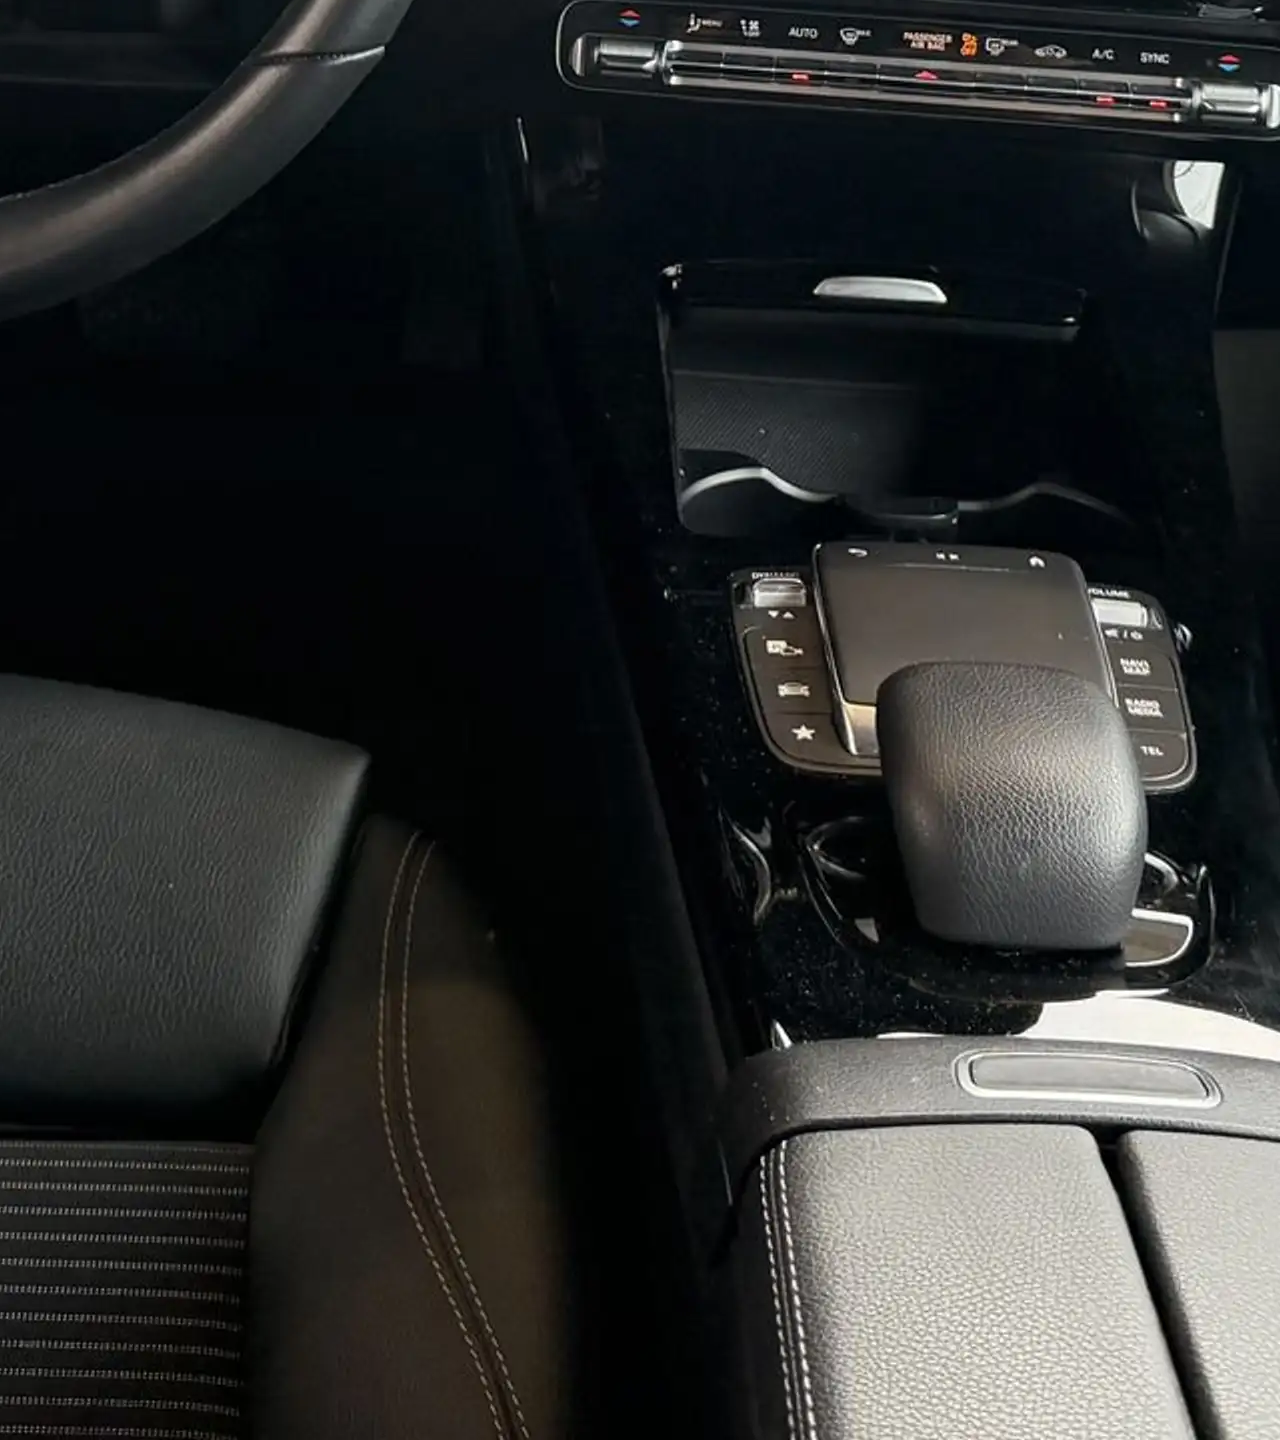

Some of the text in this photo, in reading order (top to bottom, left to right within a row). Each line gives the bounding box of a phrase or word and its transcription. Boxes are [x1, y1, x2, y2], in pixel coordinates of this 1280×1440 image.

[788, 26, 819, 40] AUTO
[903, 31, 953, 44] PASSENGER
[910, 41, 926, 49] AIR
[1092, 48, 1114, 60] A/C
[1140, 51, 1170, 64] SYNC
[1120, 658, 1150, 668] NAVI
[1124, 697, 1161, 709] RADIO
[1140, 745, 1164, 757] TEL
